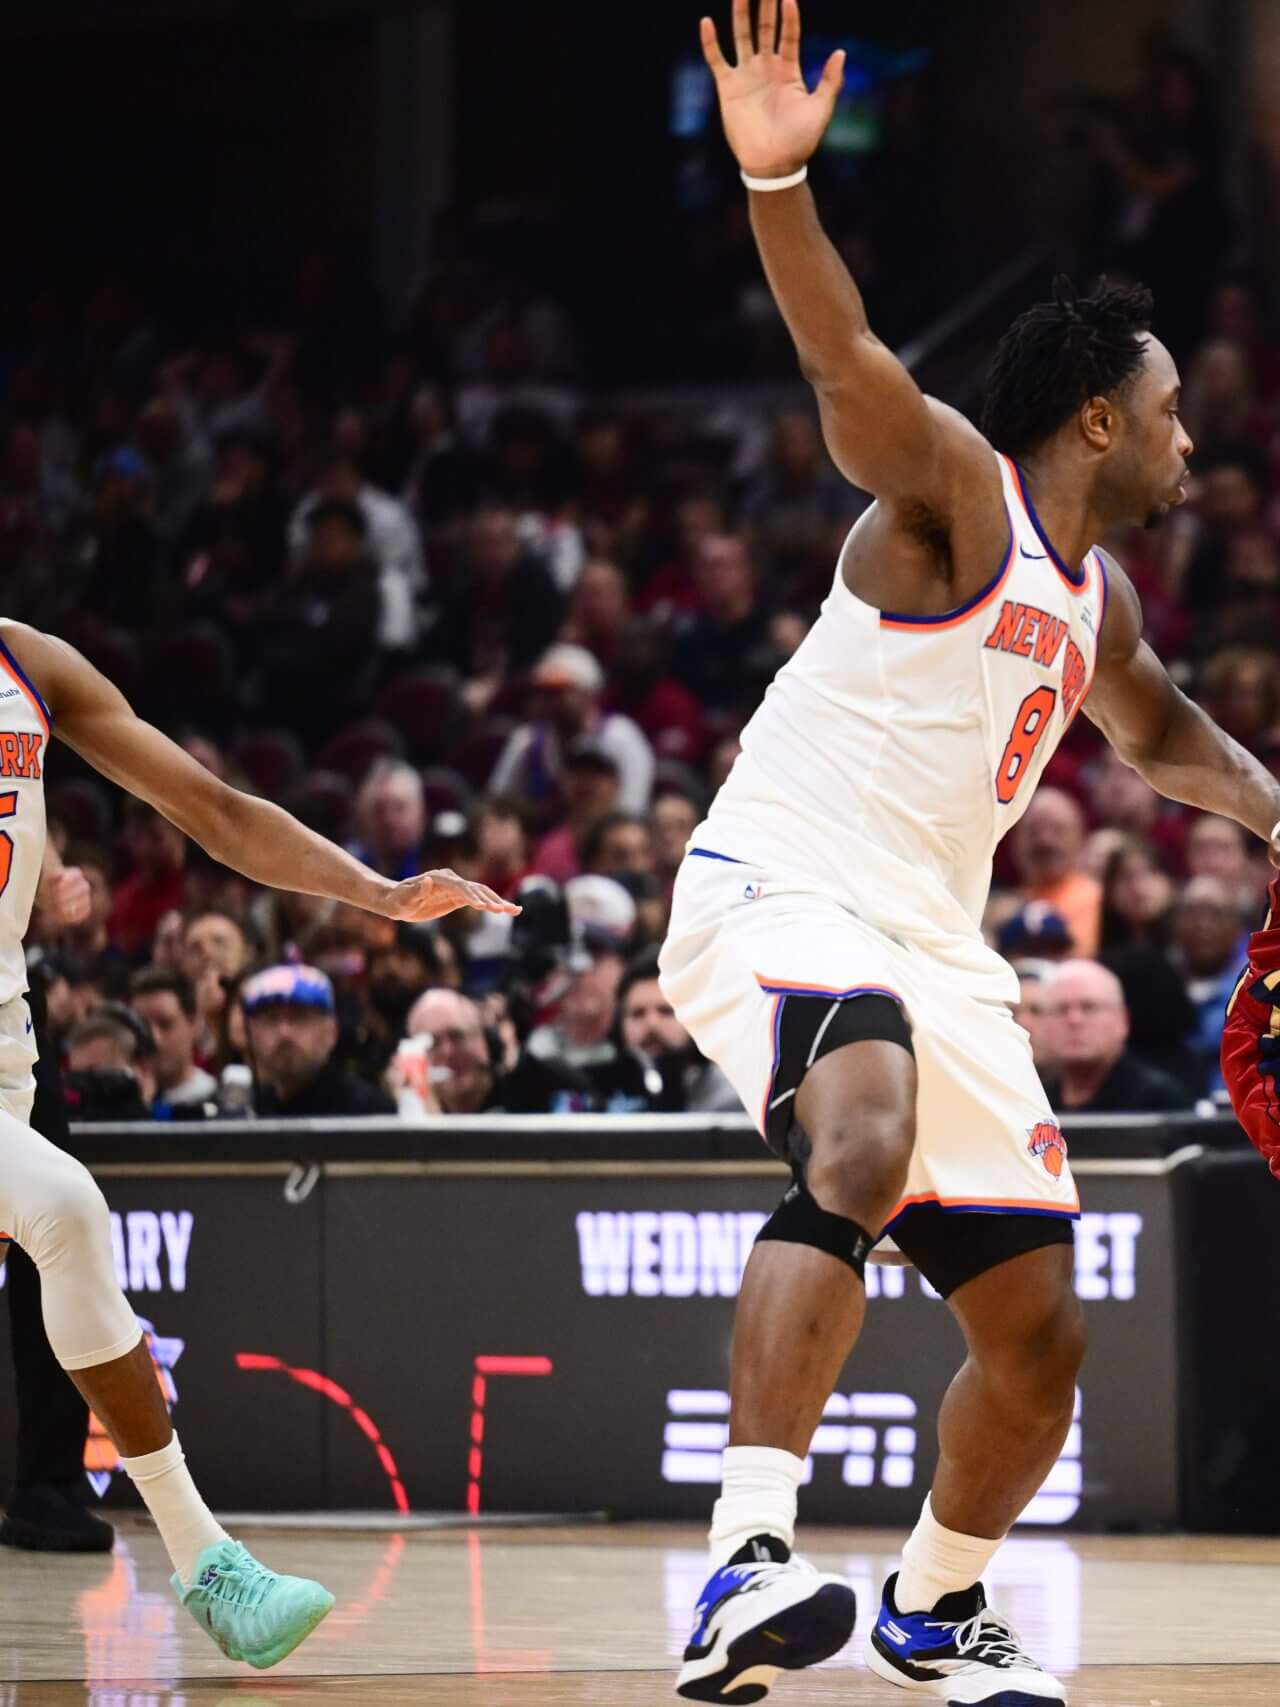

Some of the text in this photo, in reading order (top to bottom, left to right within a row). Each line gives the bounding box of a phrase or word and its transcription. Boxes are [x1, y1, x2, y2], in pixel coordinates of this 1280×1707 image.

[984, 600, 1068, 668] NEW
[0, 731, 42, 779] RK
[996, 685, 1056, 804] 8
